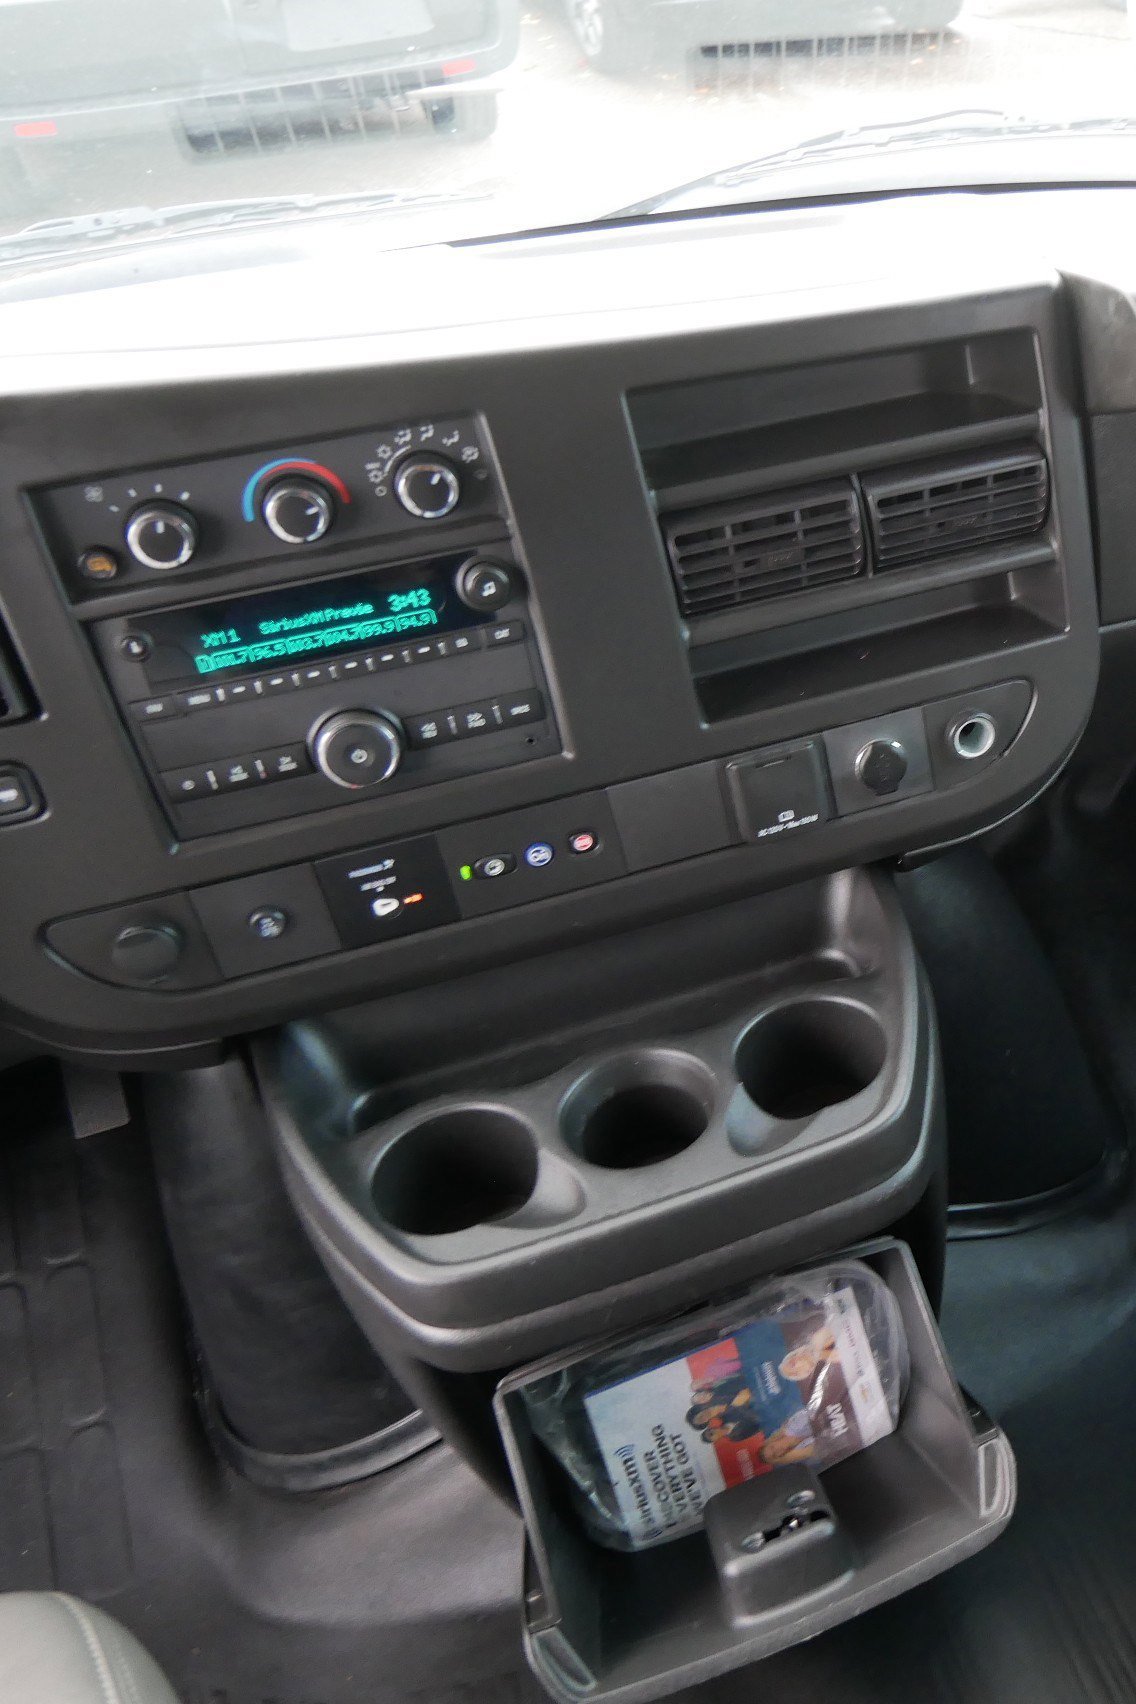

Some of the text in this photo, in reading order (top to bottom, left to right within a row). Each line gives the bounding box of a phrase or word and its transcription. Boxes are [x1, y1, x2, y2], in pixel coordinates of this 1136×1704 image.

[652, 1423, 690, 1521] VERYTHING
[669, 1432, 690, 1465] GOT
[643, 1449, 678, 1529] COVER
